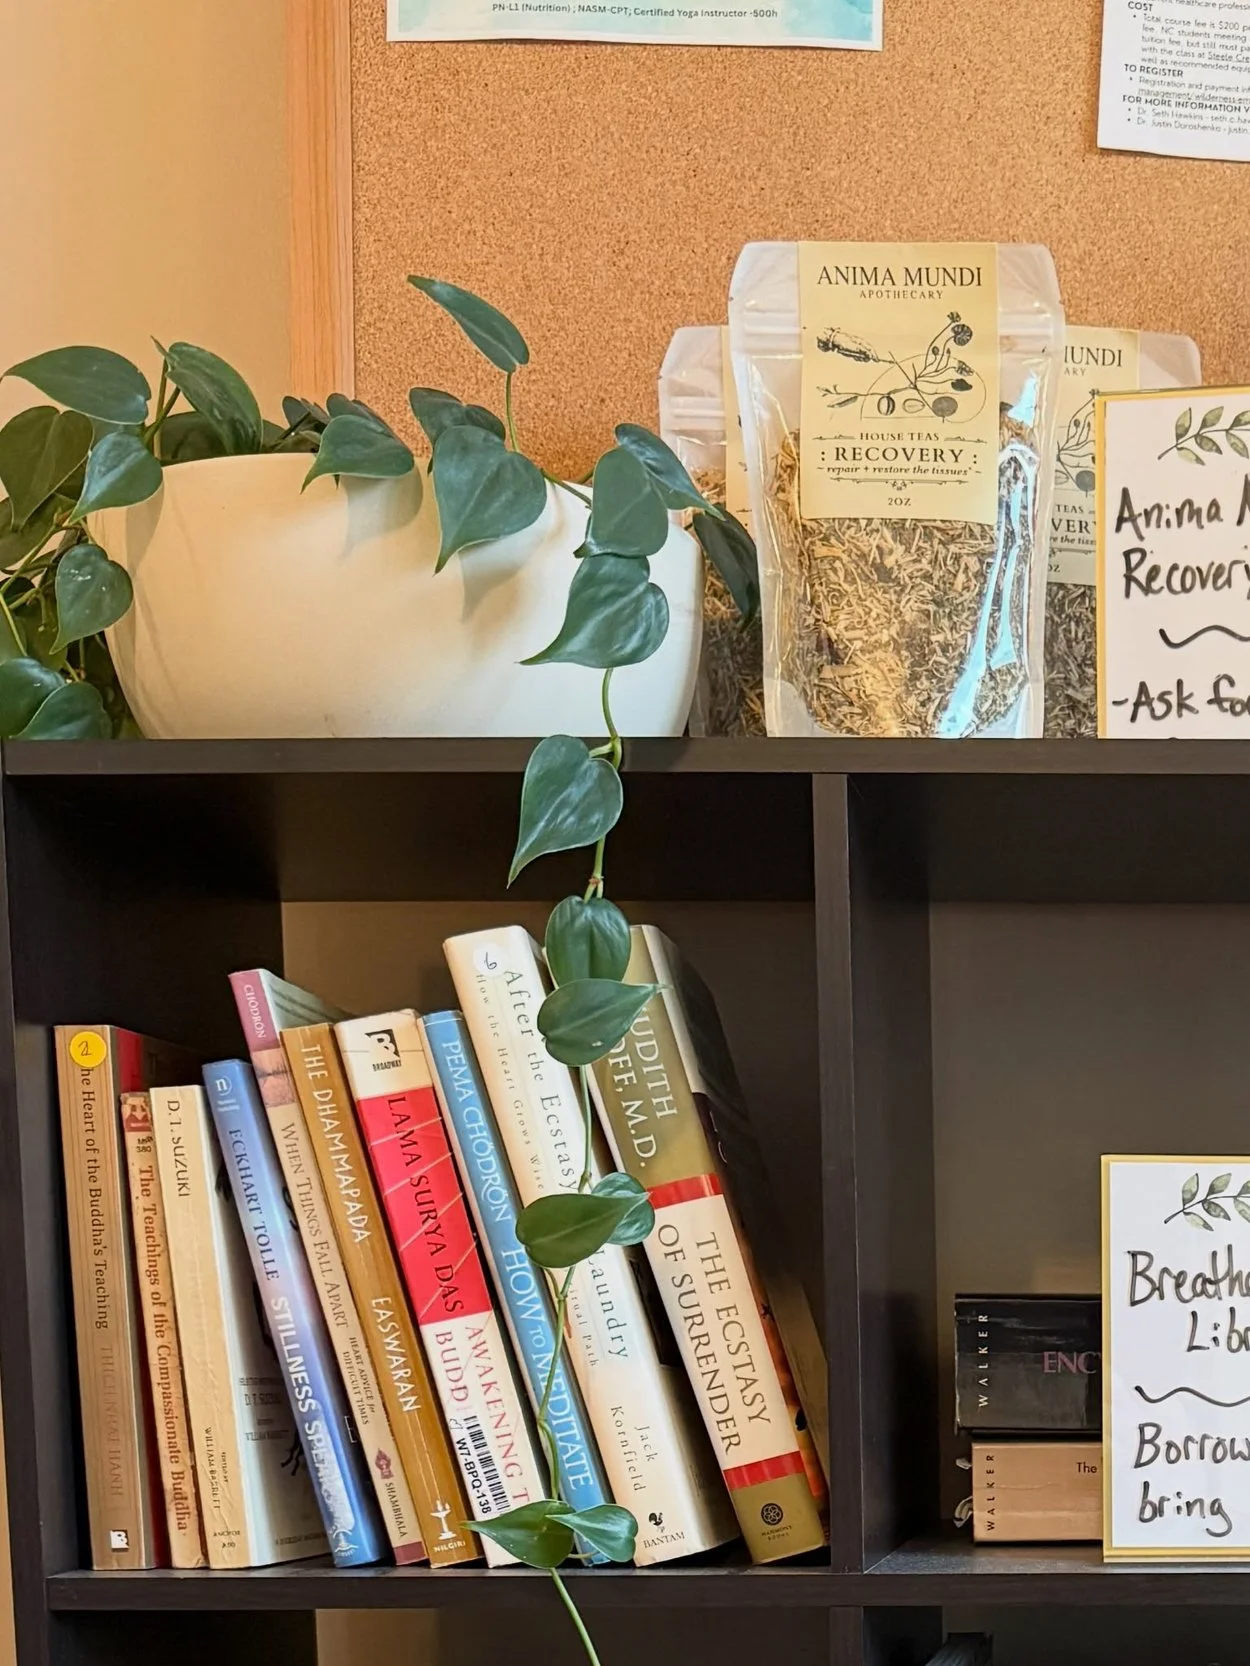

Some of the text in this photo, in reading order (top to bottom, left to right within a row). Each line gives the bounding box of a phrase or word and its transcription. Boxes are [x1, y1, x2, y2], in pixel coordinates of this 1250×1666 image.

[522, 4, 571, 12] (Nutrition)
[578, 5, 631, 16] NASM-CPT;
[634, 8, 675, 17] Certified
[677, 10, 698, 18] Yoga
[701, 10, 747, 18] Instructor
[750, 10, 777, 18] -500h
[1128, 2, 1153, 11] COST
[1124, 64, 1183, 77] TO REGISTER
[1123, 95, 1142, 104] FOR
[1145, 97, 1172, 108] MORE
[1175, 101, 1240, 112] INFORMATION
[817, 266, 982, 287] ANIMA MUNDI
[859, 289, 943, 299] APOTHECARY
[859, 432, 940, 441] HOUSE TEAS
[835, 447, 964, 462] RECOVERY
[827, 466, 860, 476] repair
[872, 466, 911, 475] restore
[913, 465, 929, 475] the
[1115, 486, 1223, 541] Anima
[387, 1096, 464, 1314] LAMA SURYA DAS
[300, 1043, 418, 1413] THE DHAMMAPADA EASWARAN
[977, 1313, 989, 1407] WALKER
[456, 1436, 492, 1515] W7-BPQ-138
[986, 1453, 995, 1531] WALKER
[1138, 1483, 1233, 1537] bring
